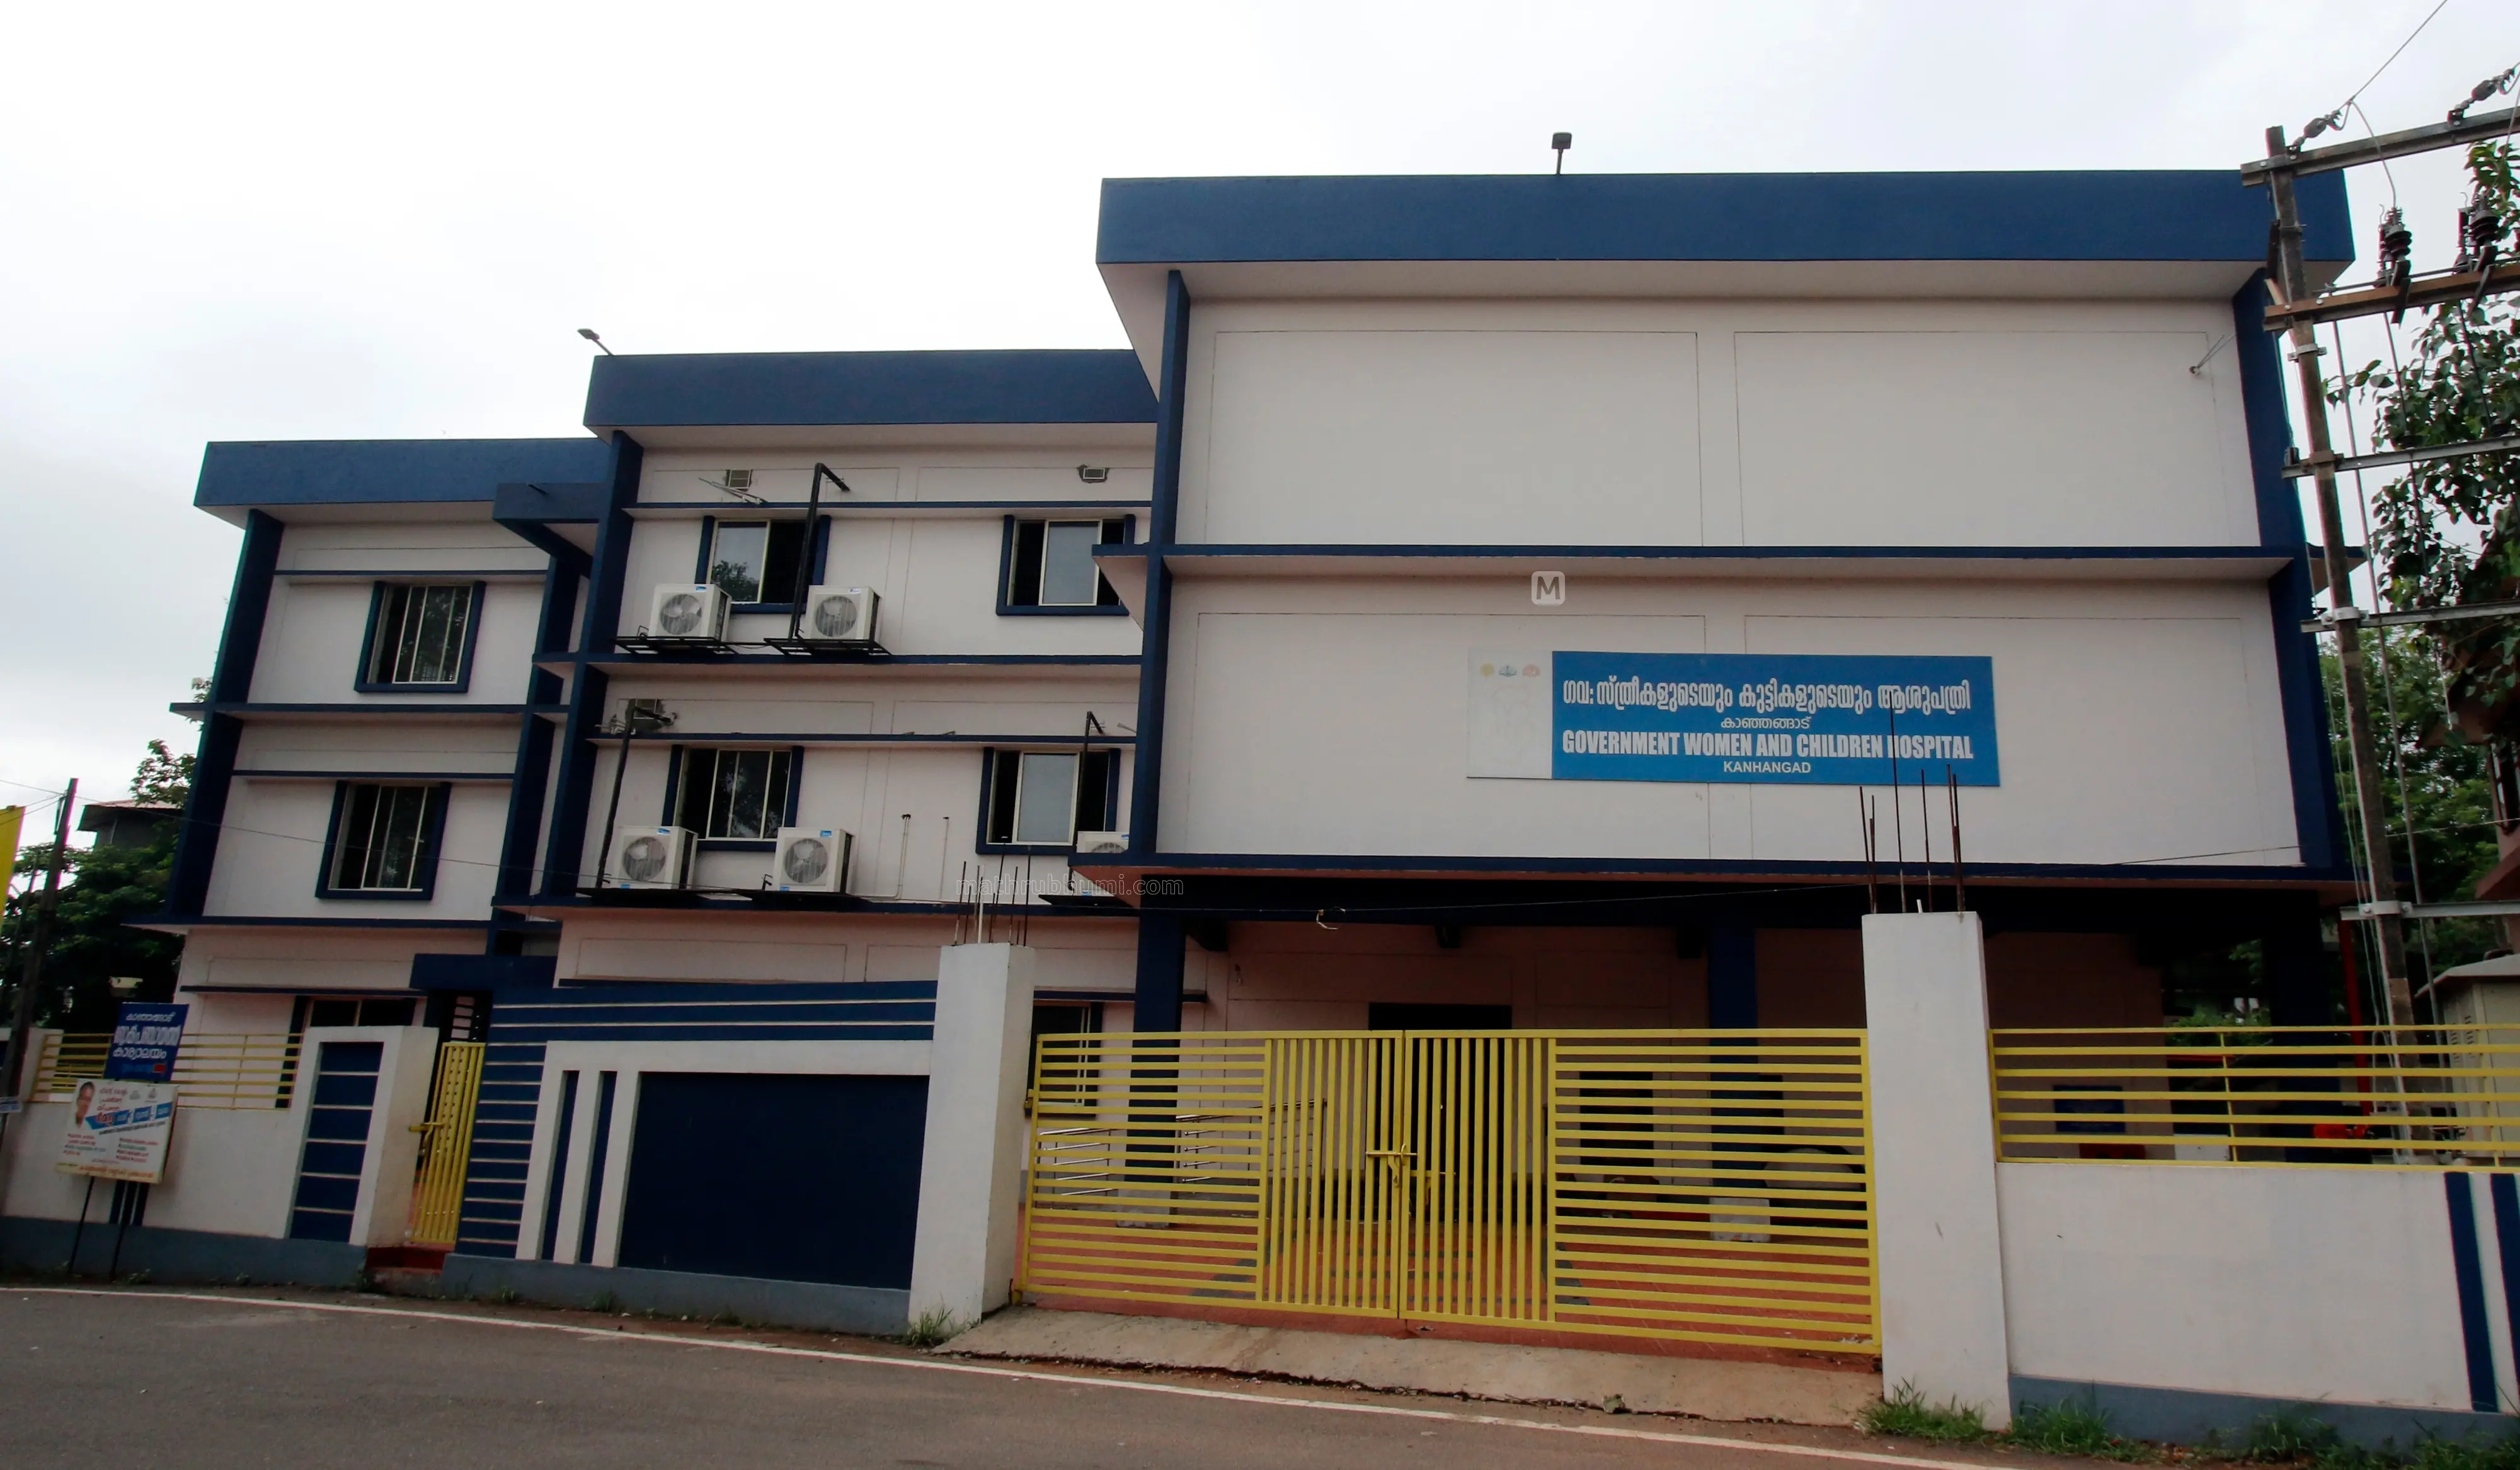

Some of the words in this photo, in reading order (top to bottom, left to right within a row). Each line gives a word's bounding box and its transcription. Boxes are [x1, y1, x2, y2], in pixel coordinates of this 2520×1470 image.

[1562, 680, 1595, 705] ഗവ:
[1596, 675, 1732, 713] സ്ത്രീകളുടെയും
[1738, 678, 1872, 715] കുട്ടികളുടെയും
[1877, 679, 1971, 716] ആശുപത്രി
[1721, 715, 1813, 729] കാഞ്ഞങ്ങാട്
[1562, 729, 1680, 755] GOVERNMENT
[1683, 732, 1752, 756] WOMEN
[1755, 733, 1792, 757] AND
[1796, 734, 1883, 758] CHILDREN
[1887, 735, 1974, 760] HOSPITAL
[1723, 761, 1811, 773] KANHANGAD
